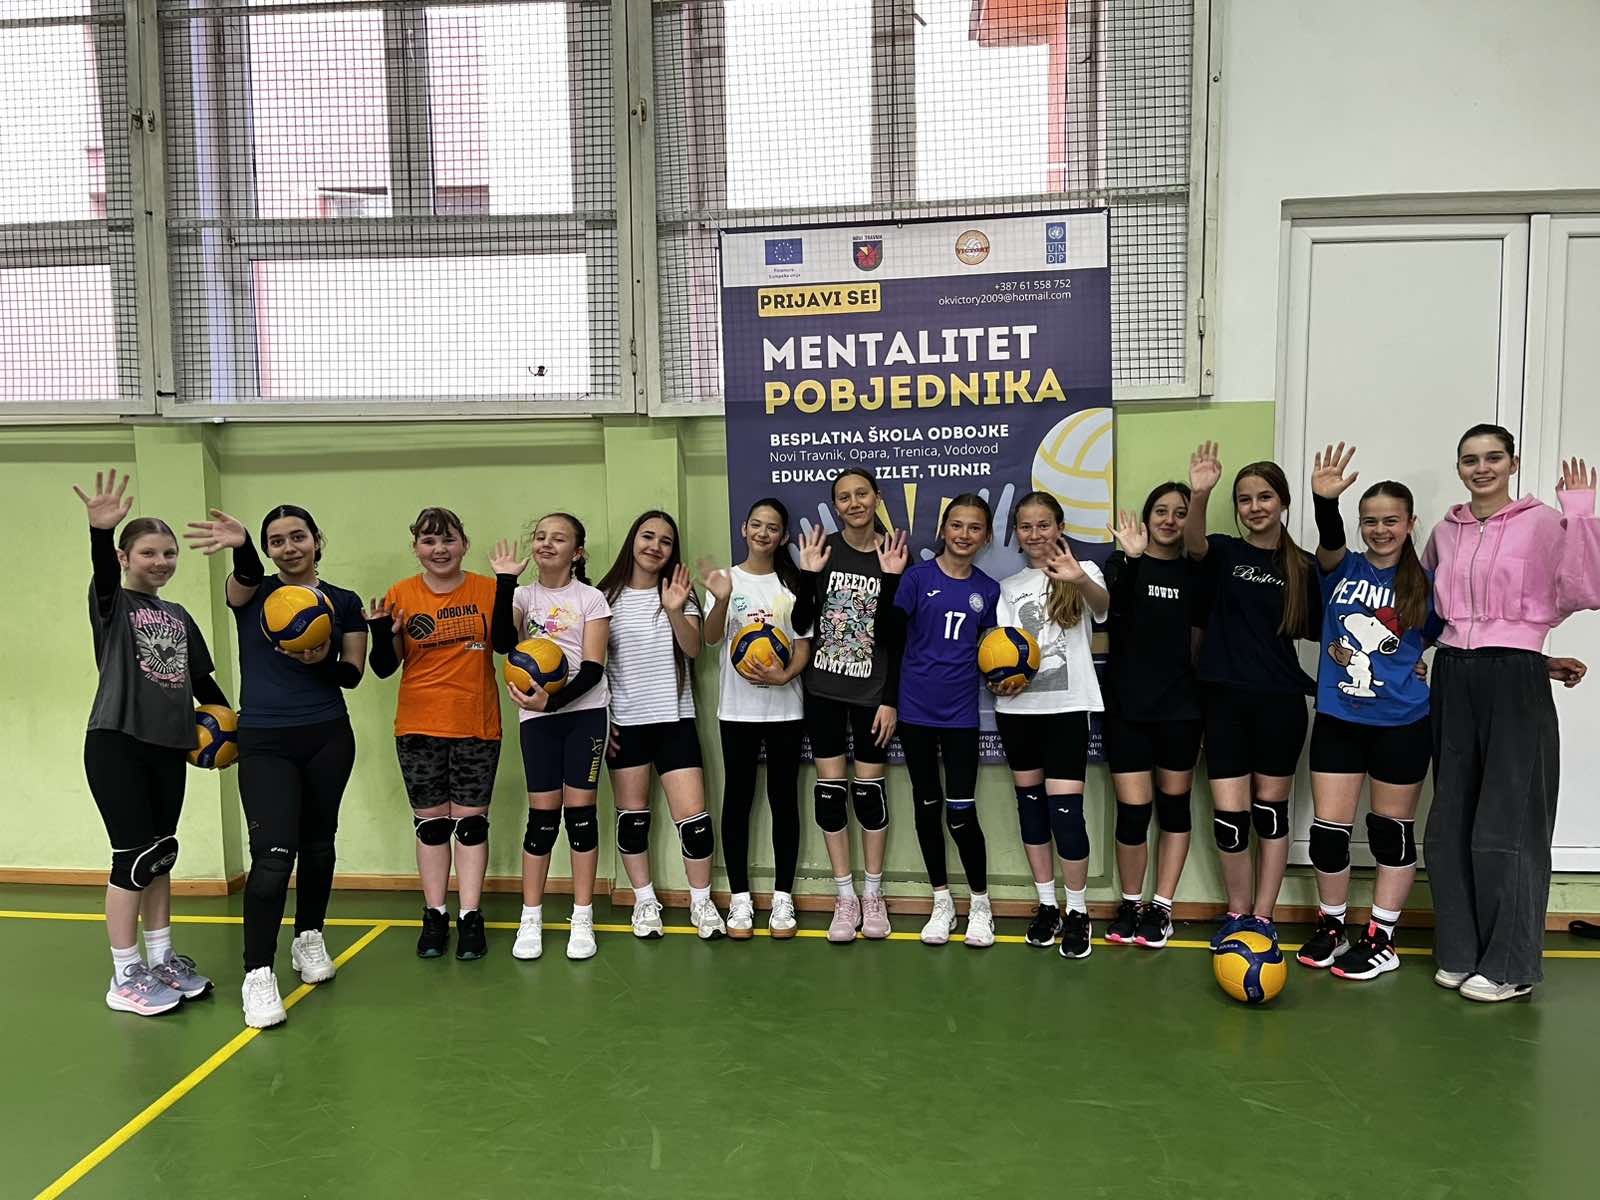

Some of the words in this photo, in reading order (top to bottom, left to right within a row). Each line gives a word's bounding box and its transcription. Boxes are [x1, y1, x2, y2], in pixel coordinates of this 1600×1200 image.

[995, 281, 1018, 291] +387
[1019, 281, 1031, 290] 61
[1033, 280, 1051, 290] 558
[1054, 279, 1071, 288] 752
[760, 290, 842, 310] PRIJAVI
[847, 289, 877, 306] SE!
[938, 291, 1072, 306] okvictory2009@hotmail.com
[762, 325, 1038, 371] MENTALITET
[764, 368, 1067, 414] POBJEDNIKA
[770, 430, 865, 447] BESPLATNA
[868, 426, 924, 442] ŠKOLA
[927, 424, 1009, 440] ODBOJKE
[769, 450, 796, 462] Novi
[799, 448, 846, 462] Travnik,
[849, 448, 890, 462] Opara,
[893, 446, 941, 458] Trenica,
[943, 442, 999, 456] Vodovod
[875, 465, 924, 480] IZLET,
[927, 462, 992, 477] TURNIR
[1232, 565, 1286, 588] Boston
[1147, 584, 1180, 600] HOWDY
[436, 604, 479, 620] ODBOJKA
[944, 610, 967, 640] 17
[844, 657, 873, 679] MIND
